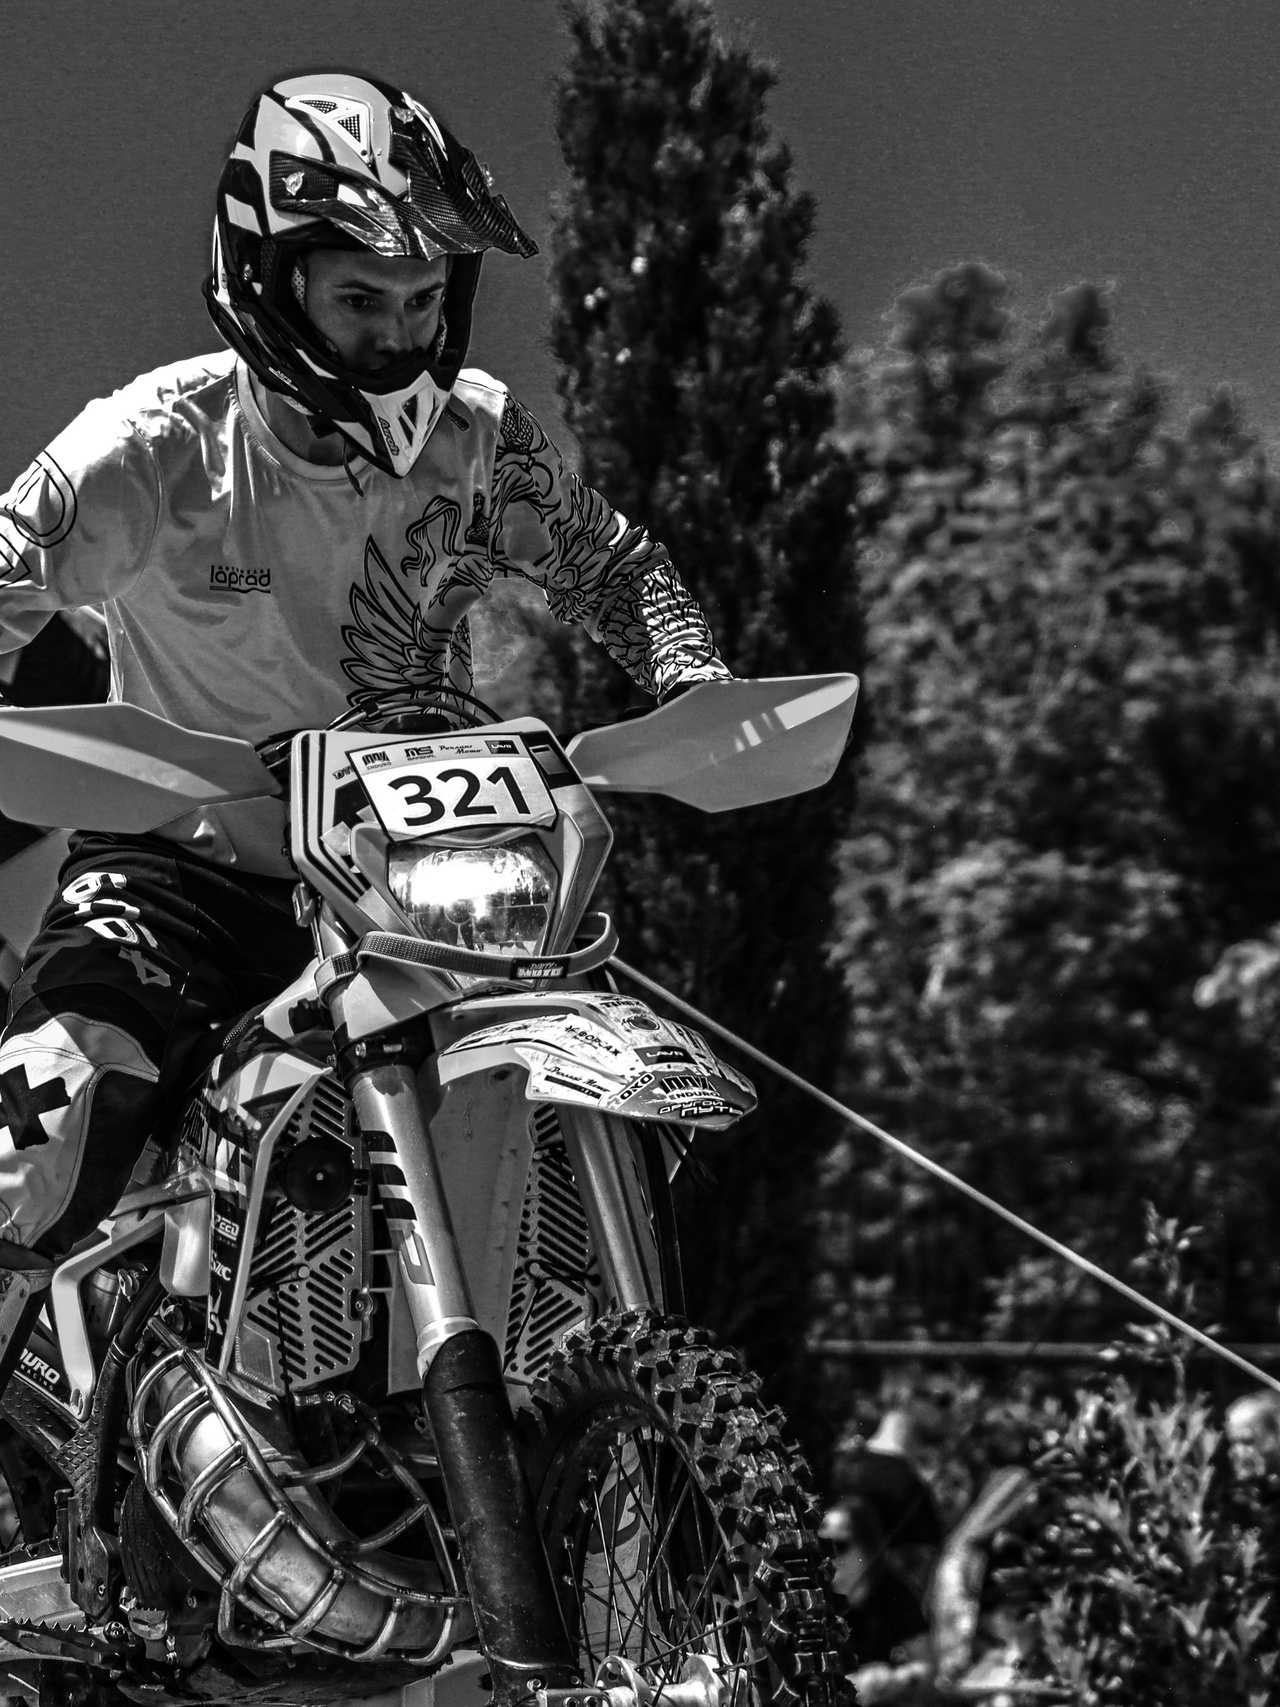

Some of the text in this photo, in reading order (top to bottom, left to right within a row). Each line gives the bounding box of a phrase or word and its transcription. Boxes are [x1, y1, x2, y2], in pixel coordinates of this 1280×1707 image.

[210, 564, 271, 587] laprad
[366, 761, 392, 771] ENDURO
[388, 766, 531, 827] 321
[517, 967, 563, 978] MOTO
[20, 1363, 54, 1391] RACING
